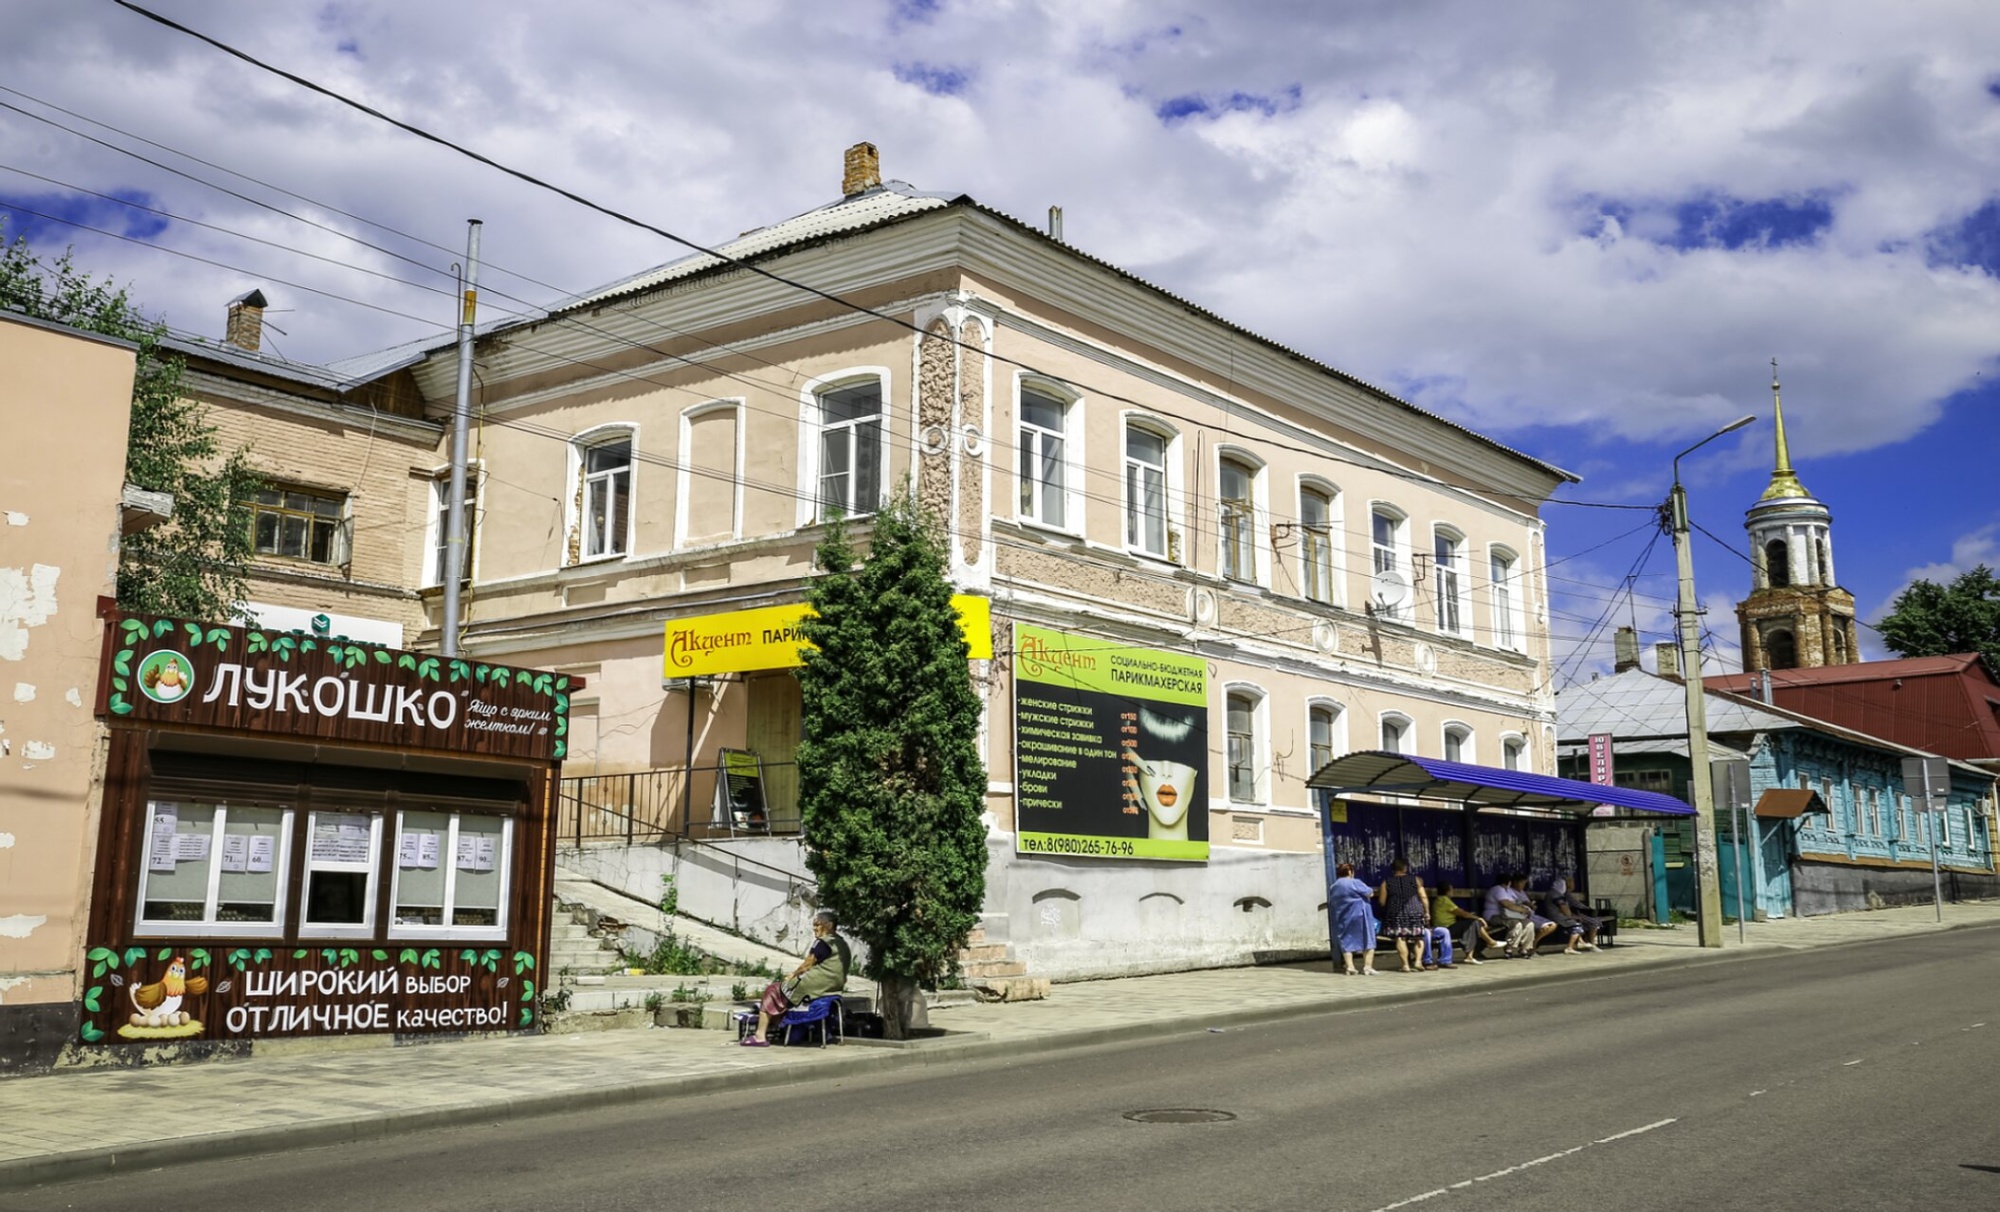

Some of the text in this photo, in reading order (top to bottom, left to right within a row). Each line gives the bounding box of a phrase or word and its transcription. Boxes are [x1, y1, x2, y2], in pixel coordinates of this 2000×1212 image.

[671, 629, 752, 668] Акцент
[1020, 633, 1096, 677] Акцент
[1111, 655, 1202, 678] СОЦИАЛЬНО-БЮДЖЕТНАЯ
[1111, 669, 1202, 694] ПАРИКМАХЕРСКАЯ
[203, 662, 457, 730] ЛУКОШКО
[500, 706, 508, 716] с
[510, 707, 551, 721] ярким
[1058, 703, 1093, 716] стрижки
[464, 719, 536, 735] желтком!
[1060, 717, 1094, 729] стрижки
[1084, 748, 1103, 759] один
[1104, 750, 1117, 759] тон
[245, 966, 471, 997] ШИРОКИЙ ВЫБОР
[226, 1001, 508, 1033] ОТЛИЧНОЕ качество!
